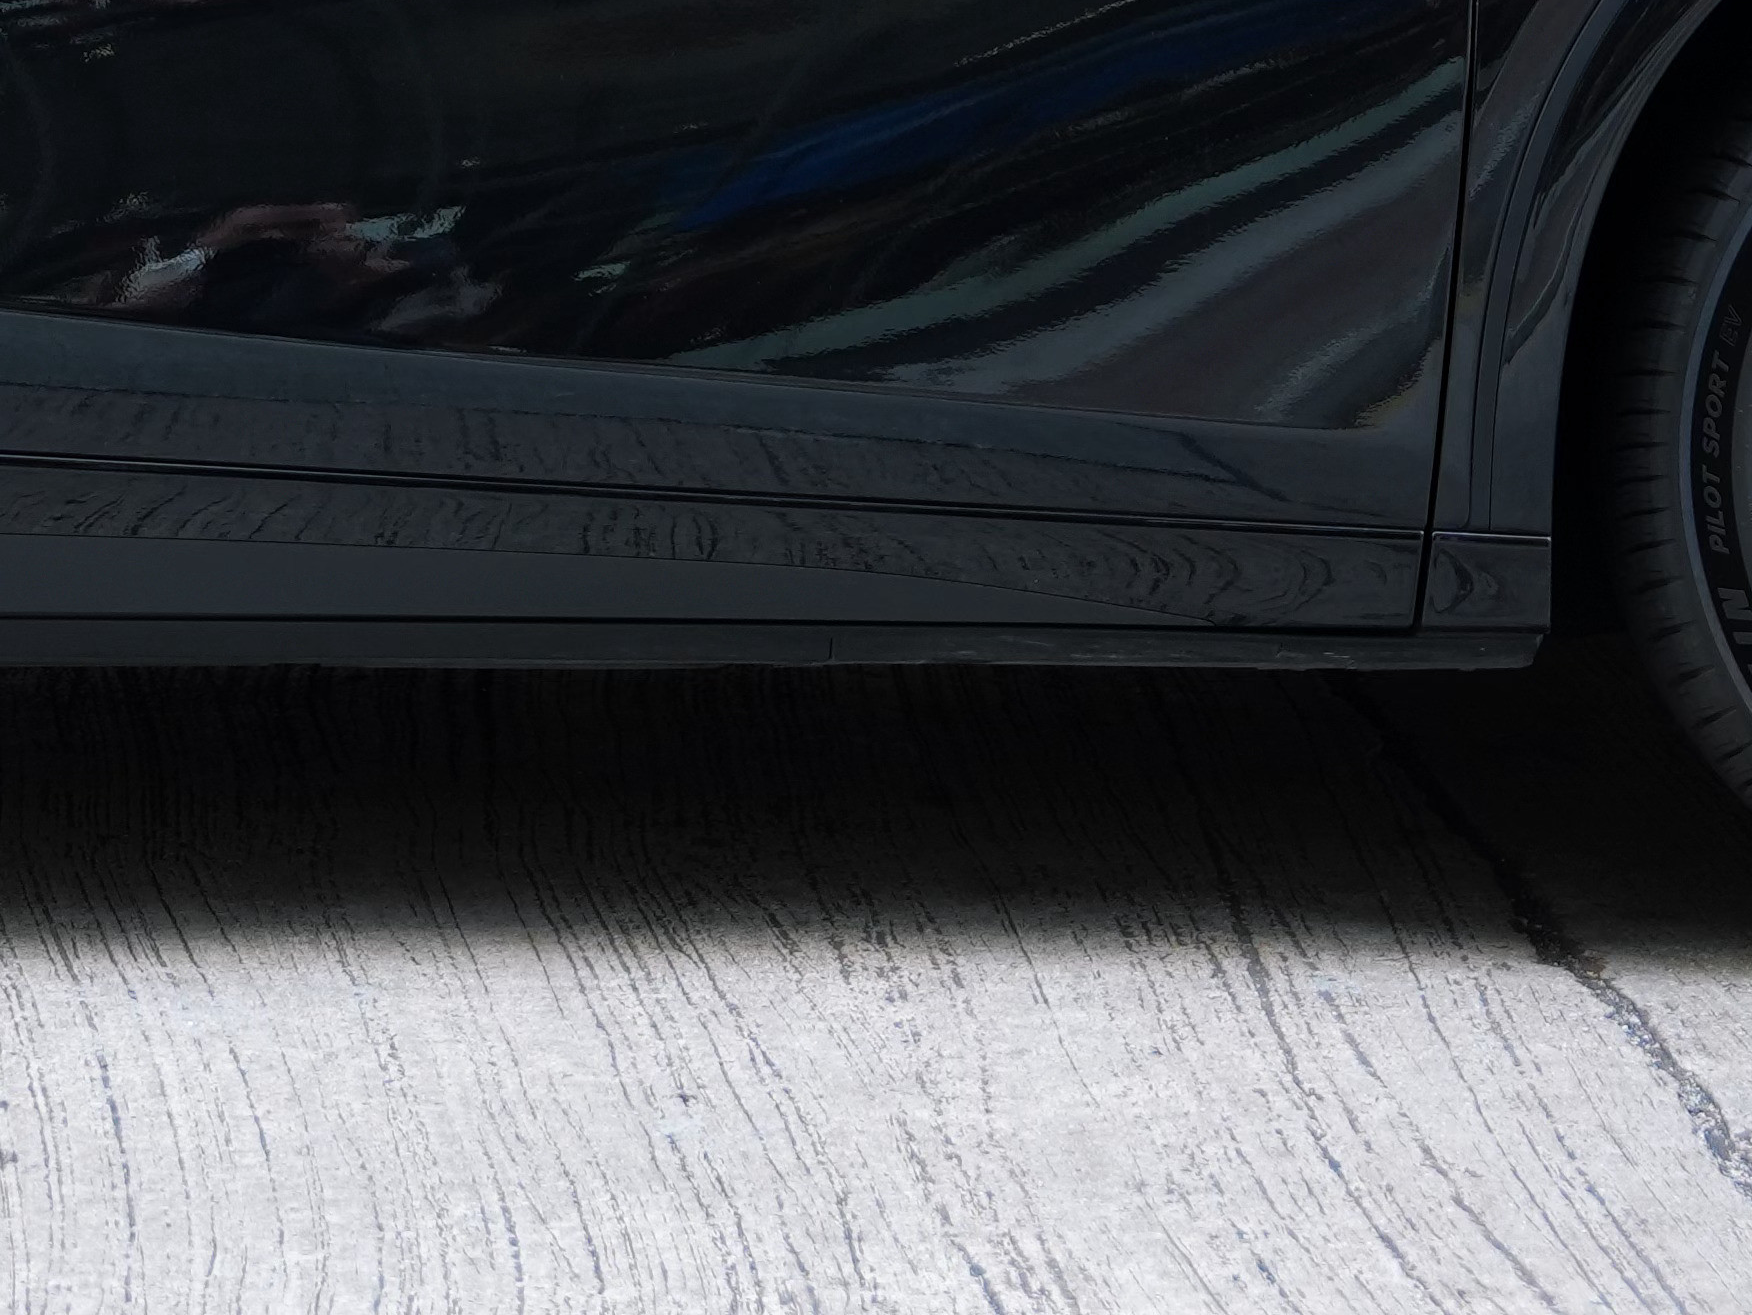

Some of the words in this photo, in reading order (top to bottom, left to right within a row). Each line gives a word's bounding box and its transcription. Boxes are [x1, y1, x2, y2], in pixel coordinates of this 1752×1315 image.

[1715, 302, 1746, 347] EV
[1698, 350, 1734, 456] SPORT
[1701, 463, 1731, 556] PILOT
